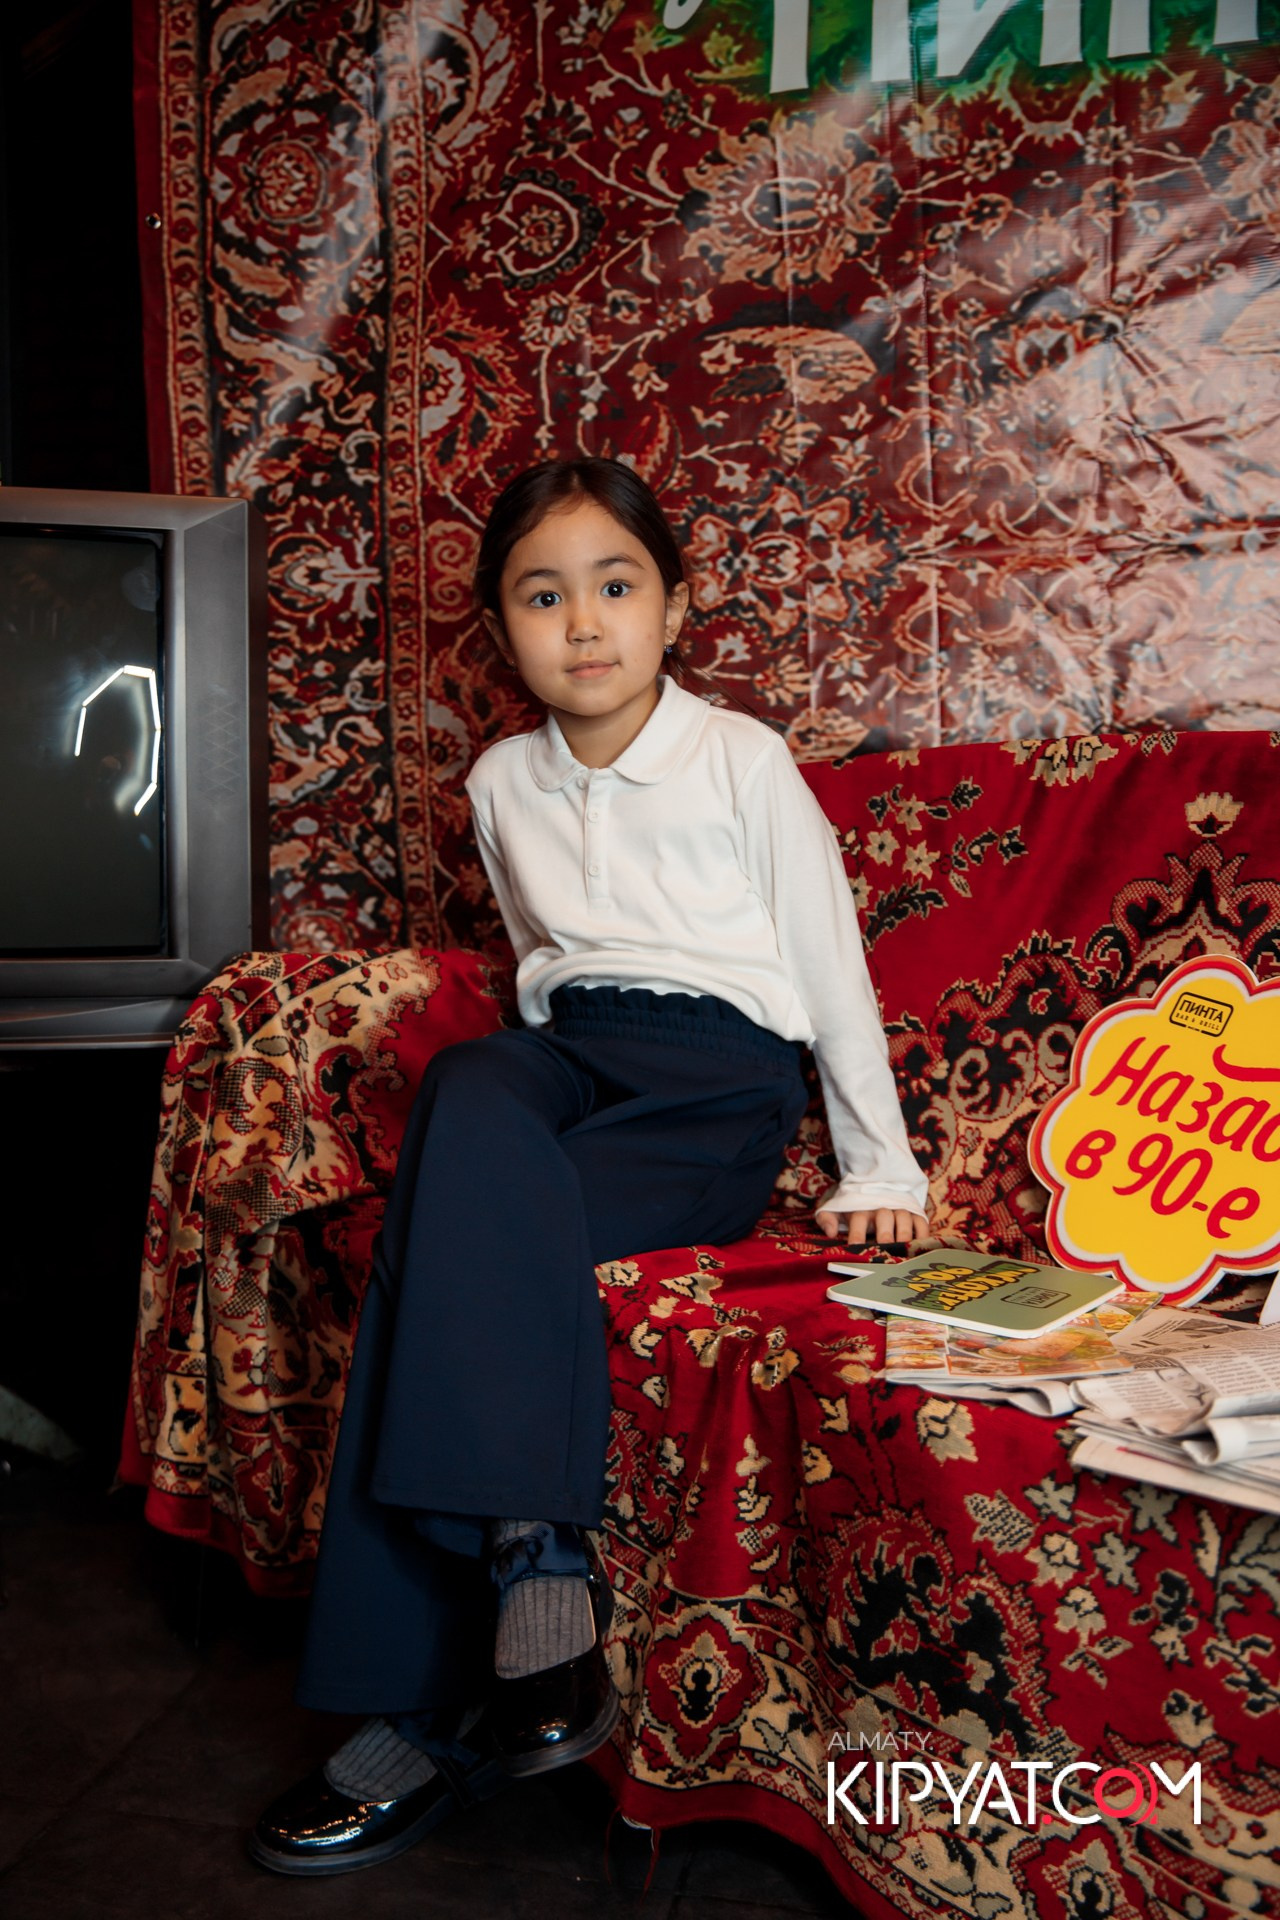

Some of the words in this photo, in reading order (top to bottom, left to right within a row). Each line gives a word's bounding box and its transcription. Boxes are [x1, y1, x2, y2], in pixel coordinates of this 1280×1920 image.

[1179, 999, 1223, 1023] ПИНТА
[1065, 1129, 1117, 1180] в
[1112, 1133, 1261, 1239] 90-е
